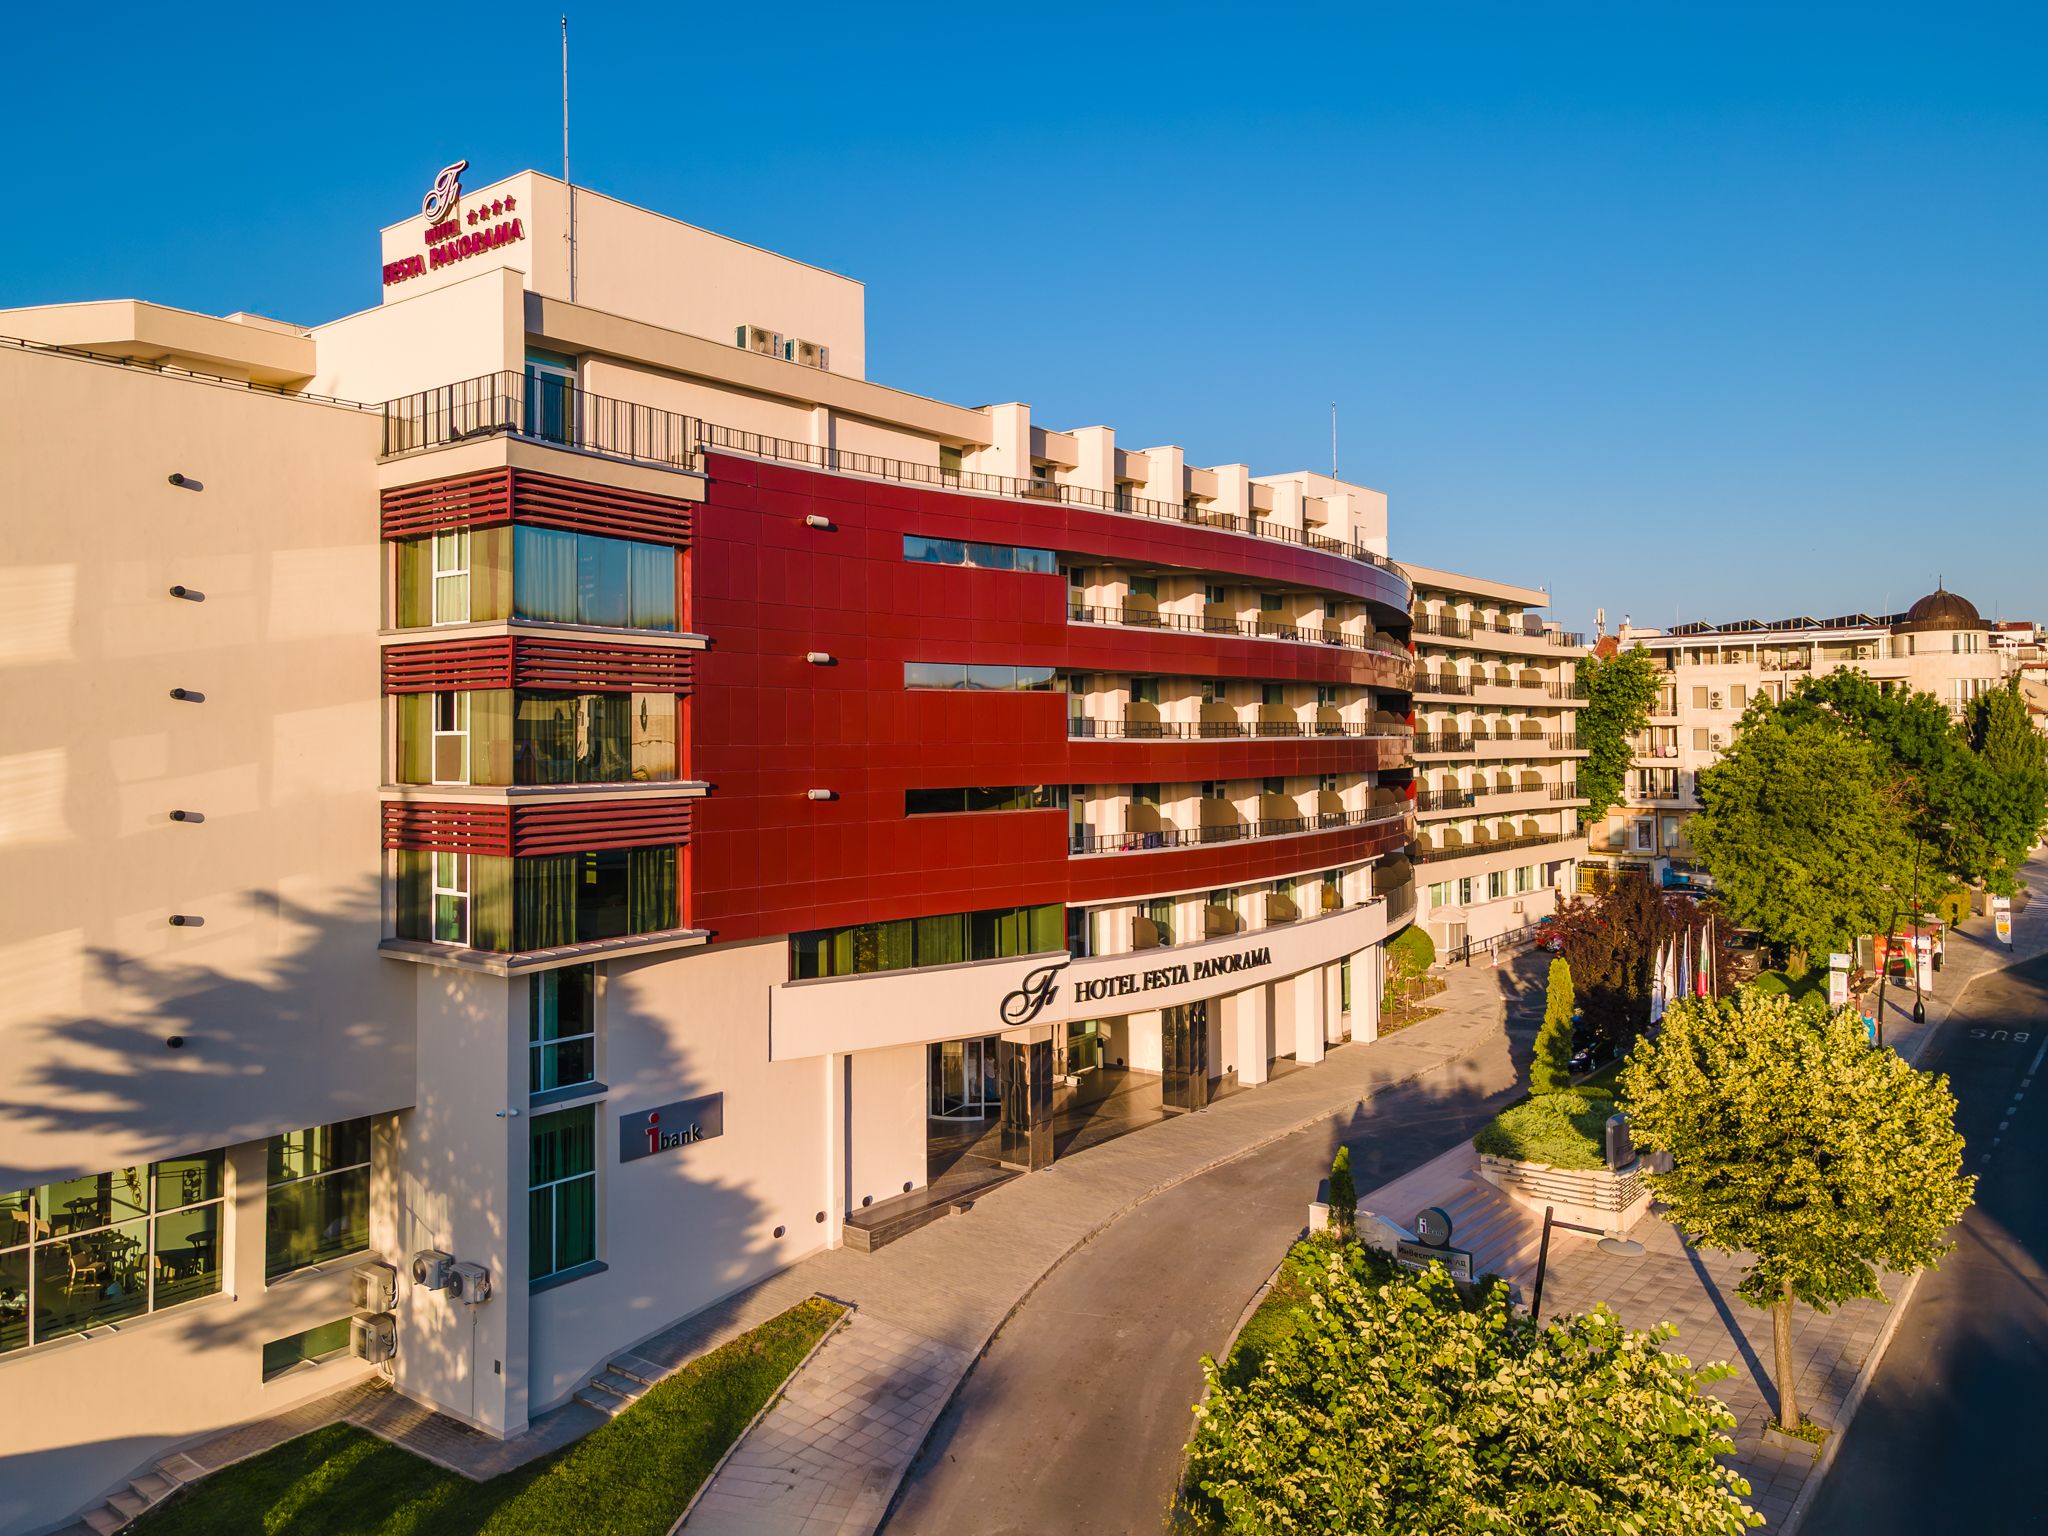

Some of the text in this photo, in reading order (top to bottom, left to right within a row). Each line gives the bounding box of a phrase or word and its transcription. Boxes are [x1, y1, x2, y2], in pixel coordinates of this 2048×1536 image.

[383, 218, 525, 286] FESTA PANORAMA
[425, 219, 462, 247] HOTEL
[1074, 947, 1272, 1003] HOTEL FESTA PANORAMA
[1969, 1028, 2030, 1043] BUS
